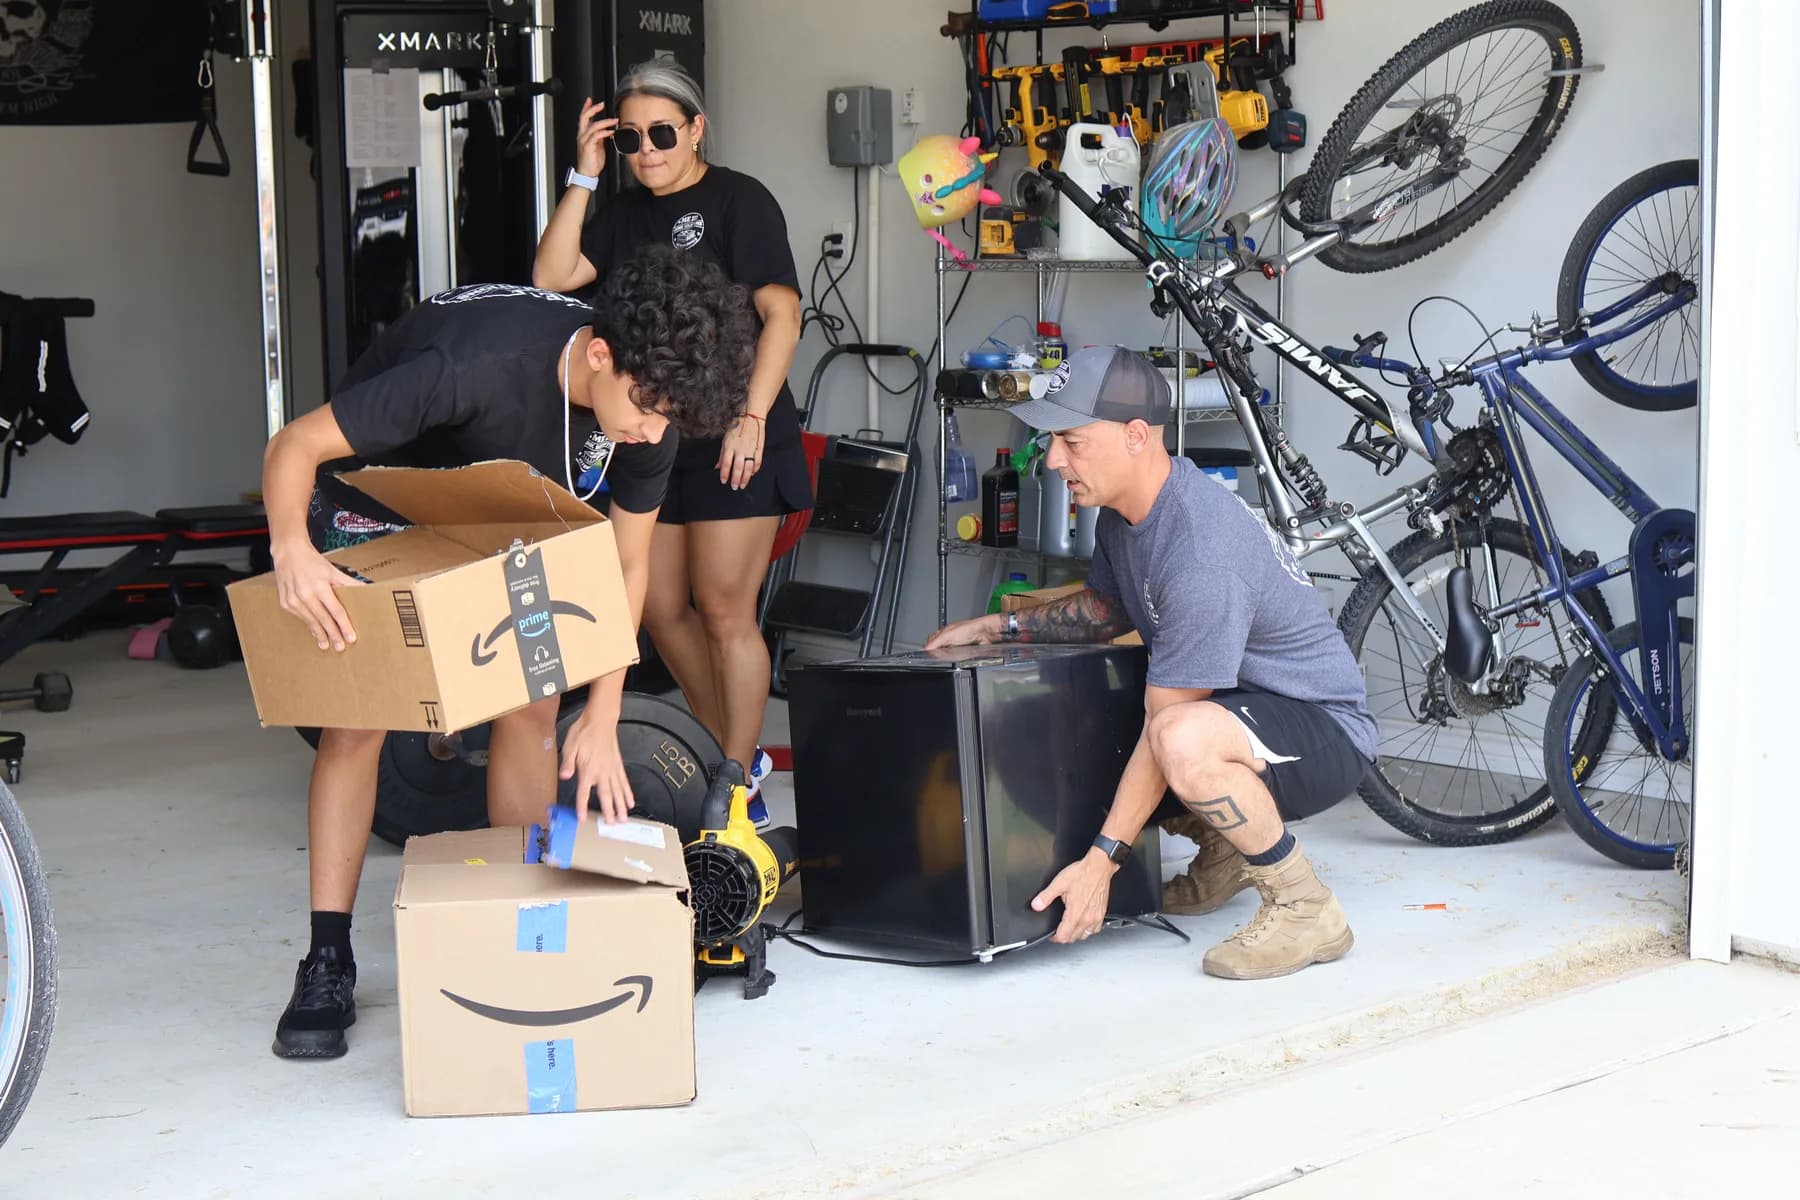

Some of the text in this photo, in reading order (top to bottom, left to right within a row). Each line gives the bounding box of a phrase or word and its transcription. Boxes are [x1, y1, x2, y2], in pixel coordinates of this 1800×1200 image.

[639, 9, 692, 36] XMARK
[378, 31, 482, 51] XMARK
[1256, 321, 1377, 402] JAMIS
[518, 610, 549, 632] prime
[1650, 649, 1663, 695] JETSON
[651, 739, 679, 772] 15
[665, 756, 696, 789] LB
[1507, 795, 1555, 829] SAGUARO
[547, 1047, 556, 1071] here.
